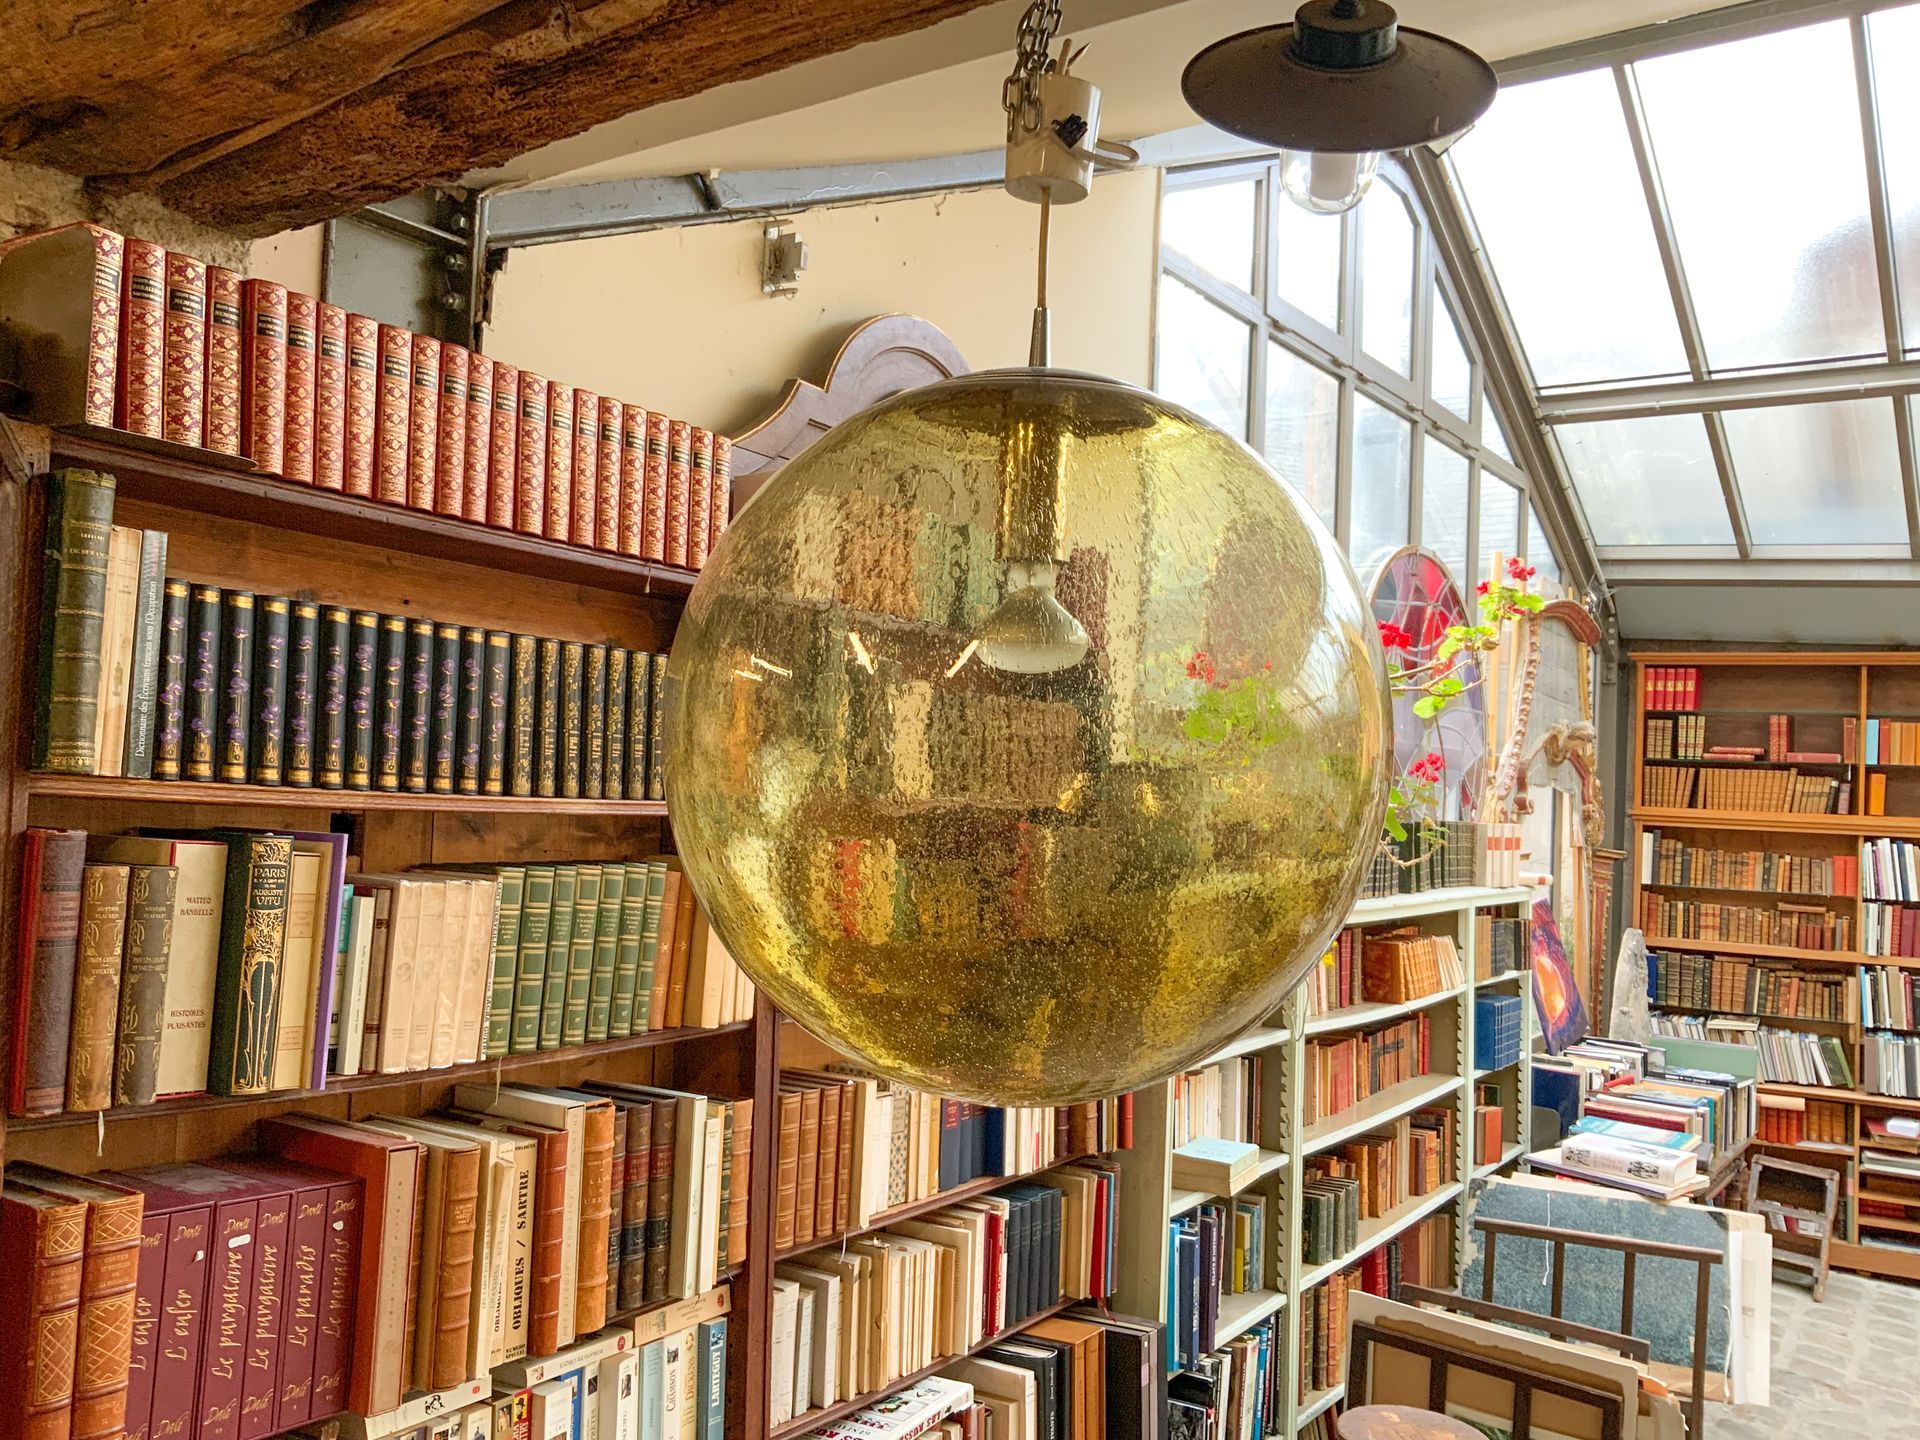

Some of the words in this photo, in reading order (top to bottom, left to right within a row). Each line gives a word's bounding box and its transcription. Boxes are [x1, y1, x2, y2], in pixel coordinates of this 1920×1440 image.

[145, 581, 159, 624] l'Occupation
[146, 625, 154, 641] sous
[143, 641, 154, 667] français
[138, 701, 149, 713] des
[135, 714, 147, 757] Dictionnaire
[254, 868, 286, 878] PARIS
[186, 897, 212, 905] MATTEO
[253, 888, 284, 896] AUGUSTE
[256, 896, 281, 906] VITU
[180, 908, 215, 916] BANDELLO
[170, 1008, 205, 1018] HISTOIRES
[167, 1020, 207, 1030] PLAISANTES
[517, 1170, 530, 1230] SARTRE
[295, 1245, 316, 1318] paradis
[512, 1257, 525, 1330] OBLIQUES
[287, 1325, 308, 1348] Le
[211, 1357, 234, 1379] Le
[248, 1349, 270, 1371] Le
[926, 1410, 942, 1428] LES
